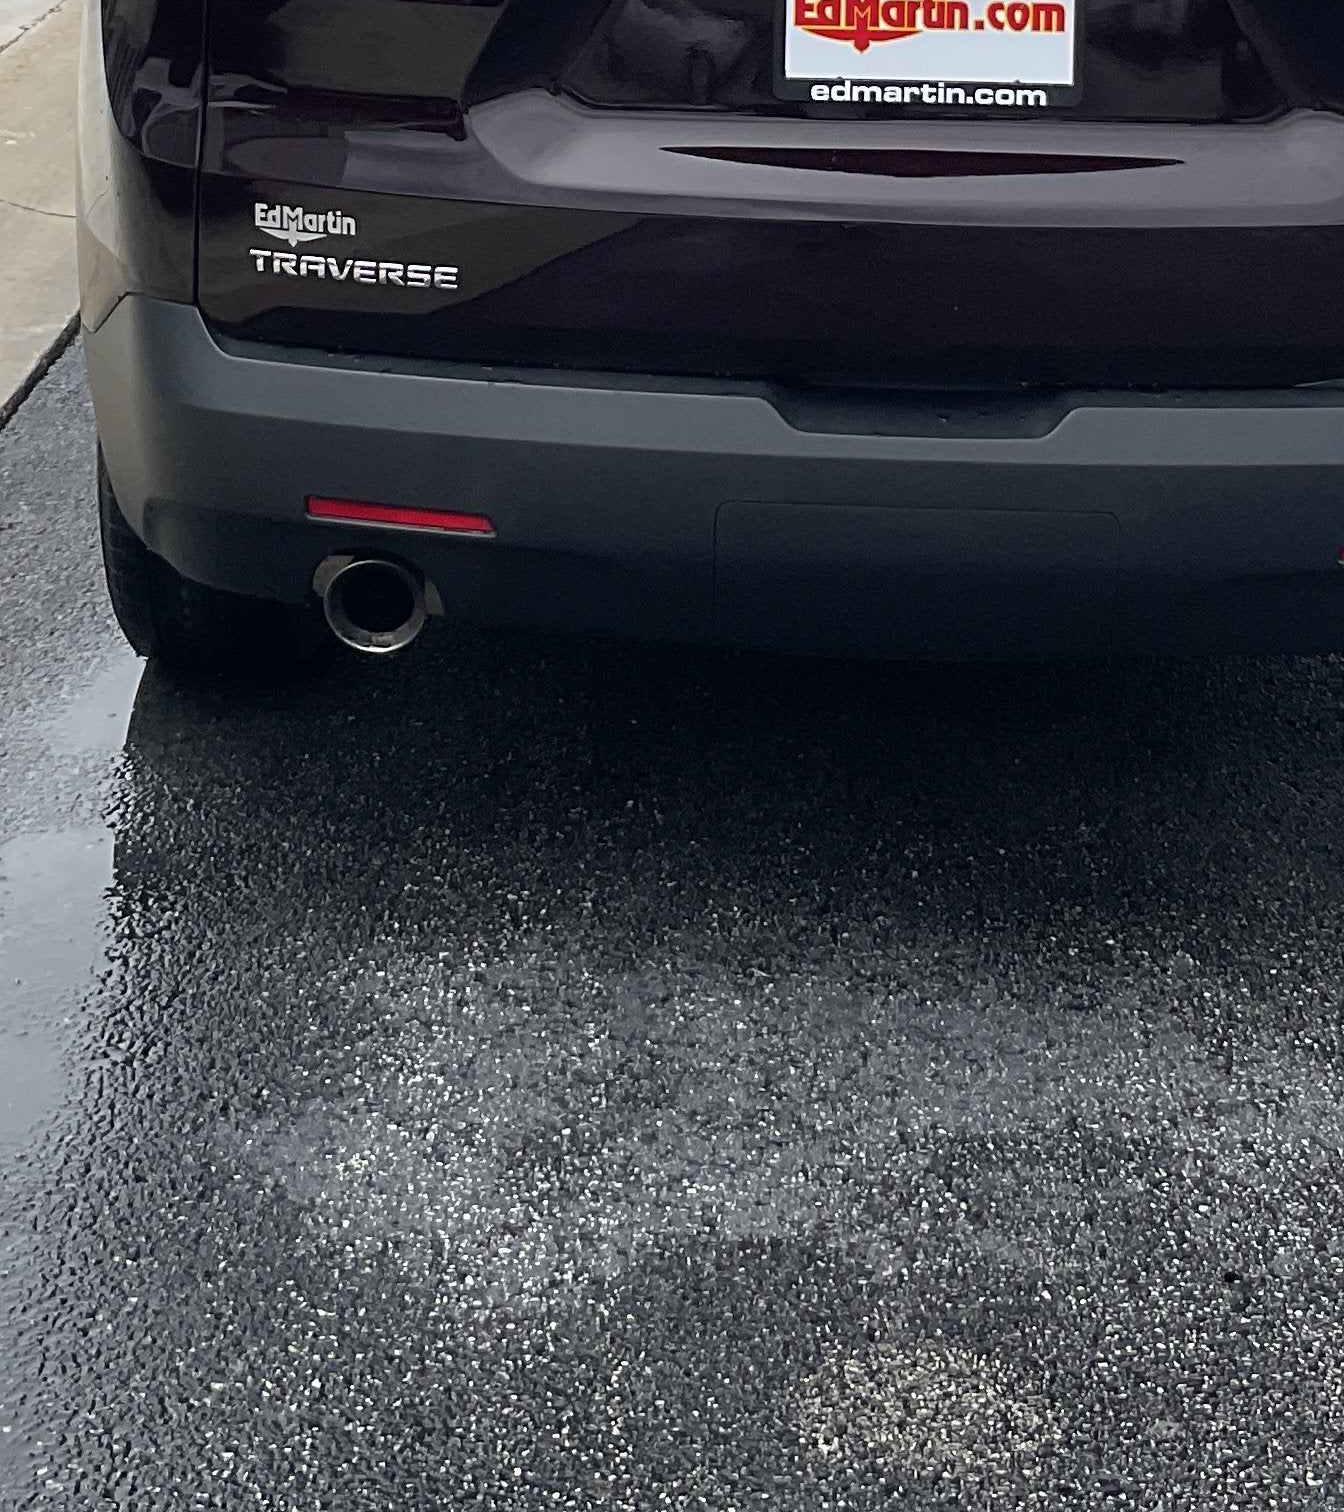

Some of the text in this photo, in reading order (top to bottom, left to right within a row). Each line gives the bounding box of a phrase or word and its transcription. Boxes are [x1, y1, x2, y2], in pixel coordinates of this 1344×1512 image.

[810, 80, 1048, 107] edmartin.com
[254, 202, 356, 238] EdMartin
[249, 248, 458, 289] TRAVERSE
